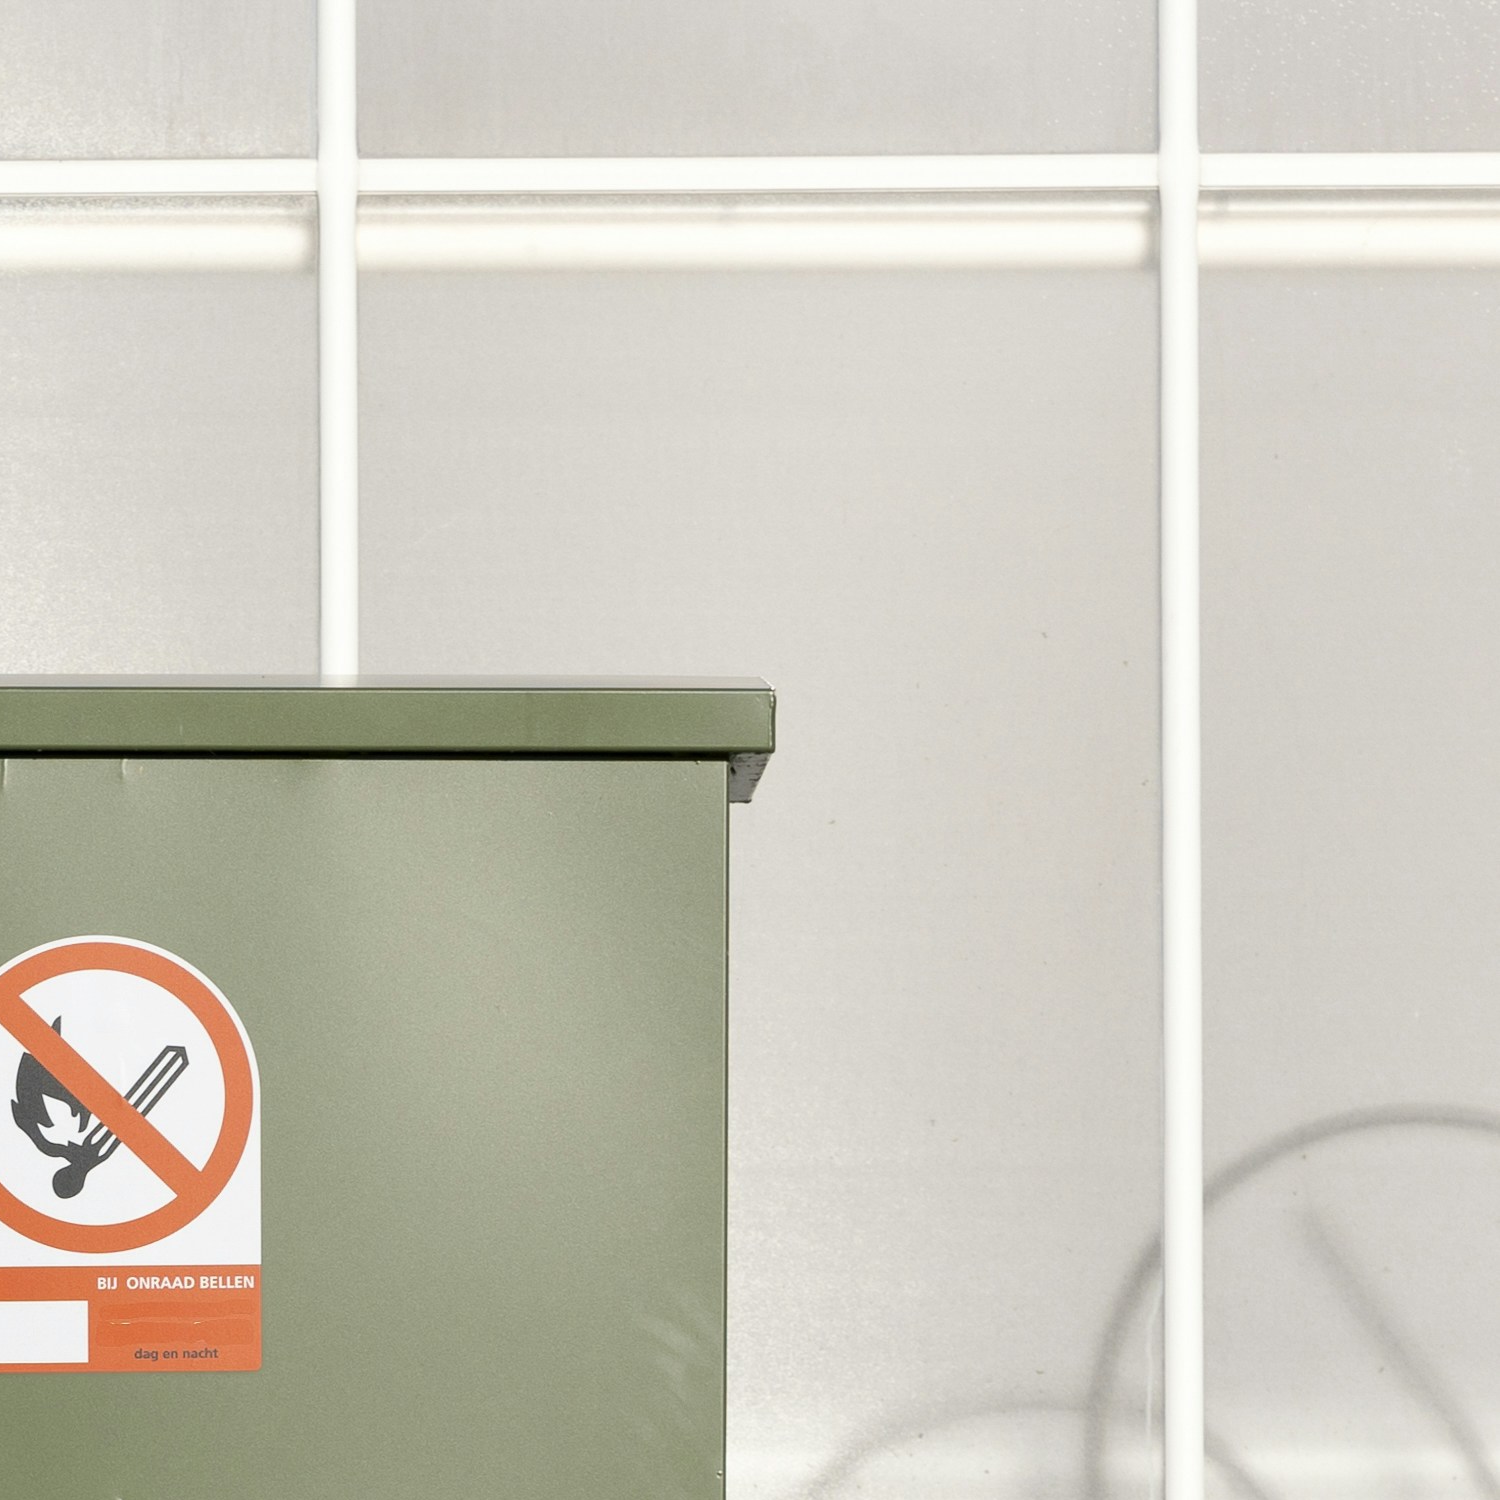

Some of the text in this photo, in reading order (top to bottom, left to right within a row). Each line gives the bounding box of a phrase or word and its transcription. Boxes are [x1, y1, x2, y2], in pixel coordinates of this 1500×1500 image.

[97, 1275, 255, 1290] BIJ ONRAAD BELLEN
[134, 1348, 219, 1361] dag en nacht
